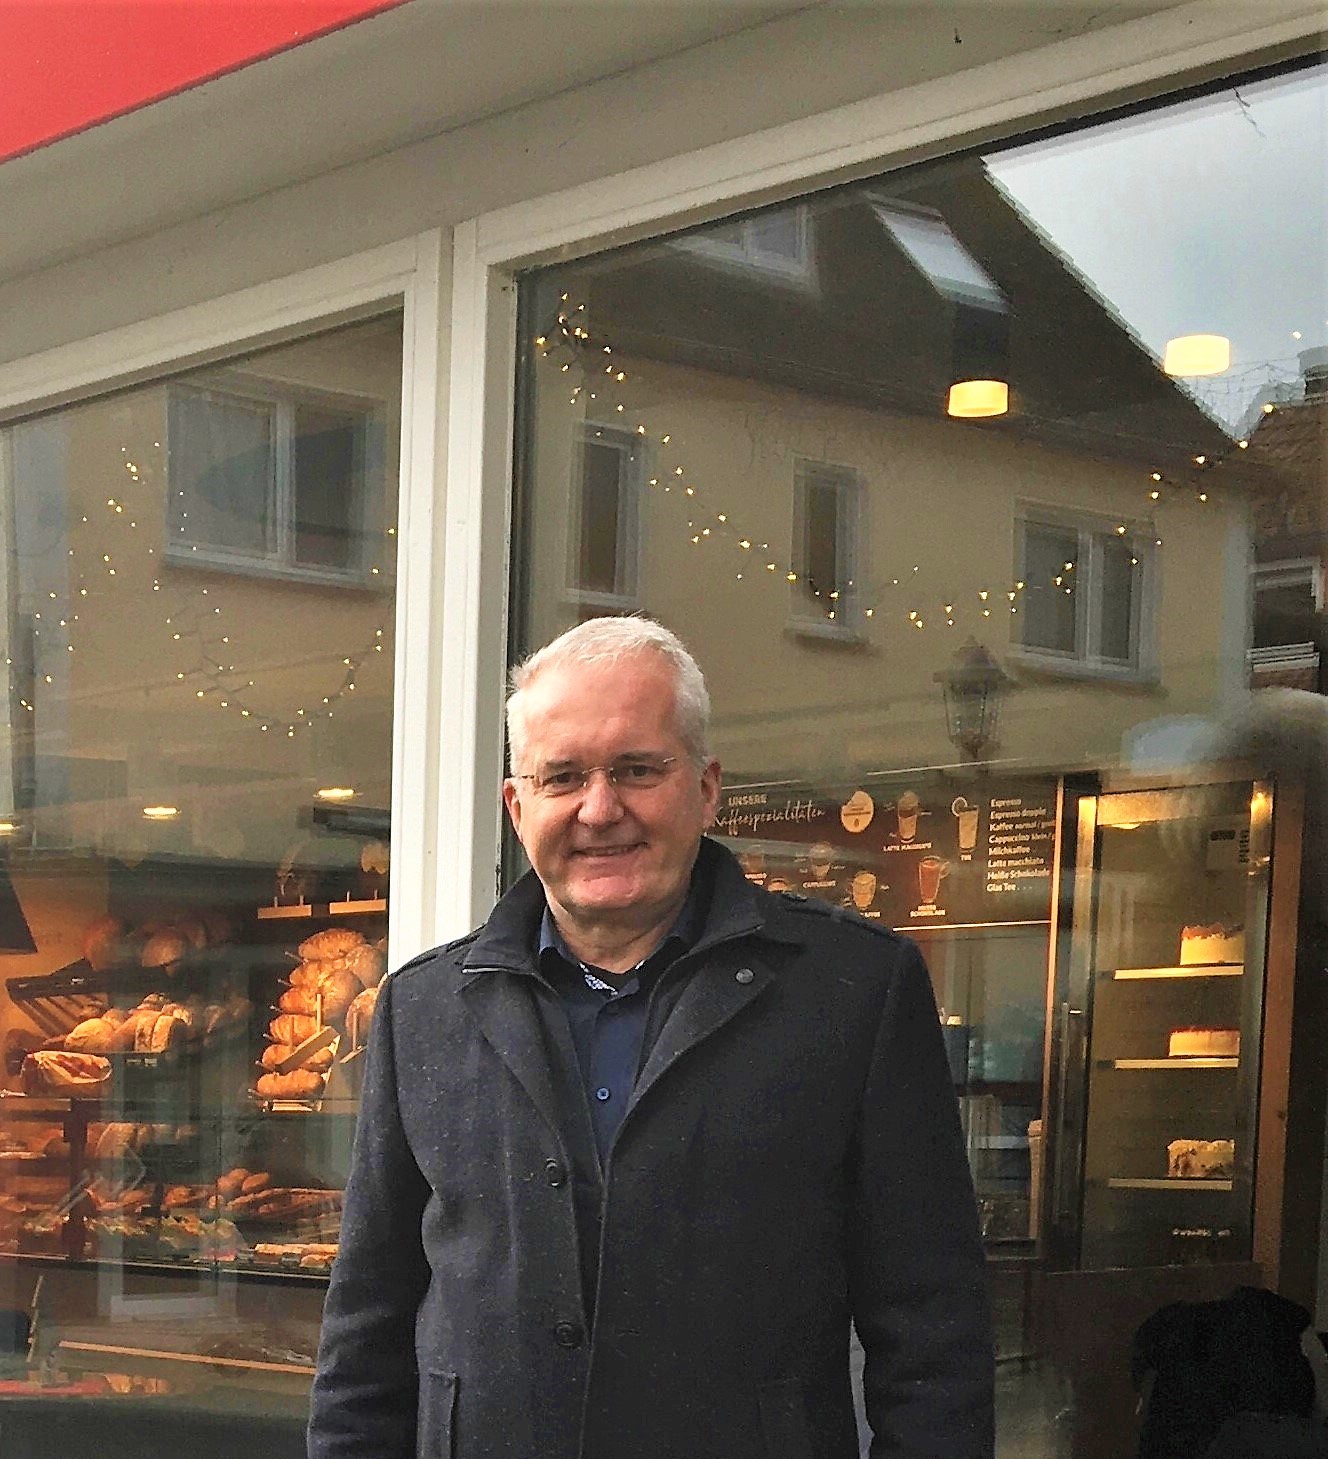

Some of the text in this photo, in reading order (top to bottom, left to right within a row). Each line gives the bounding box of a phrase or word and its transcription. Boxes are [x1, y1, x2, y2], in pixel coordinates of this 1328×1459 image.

[990, 798, 1022, 809] Espresso
[988, 845, 1031, 856] Milchkaffee
[986, 882, 1017, 892] Glas Tee
